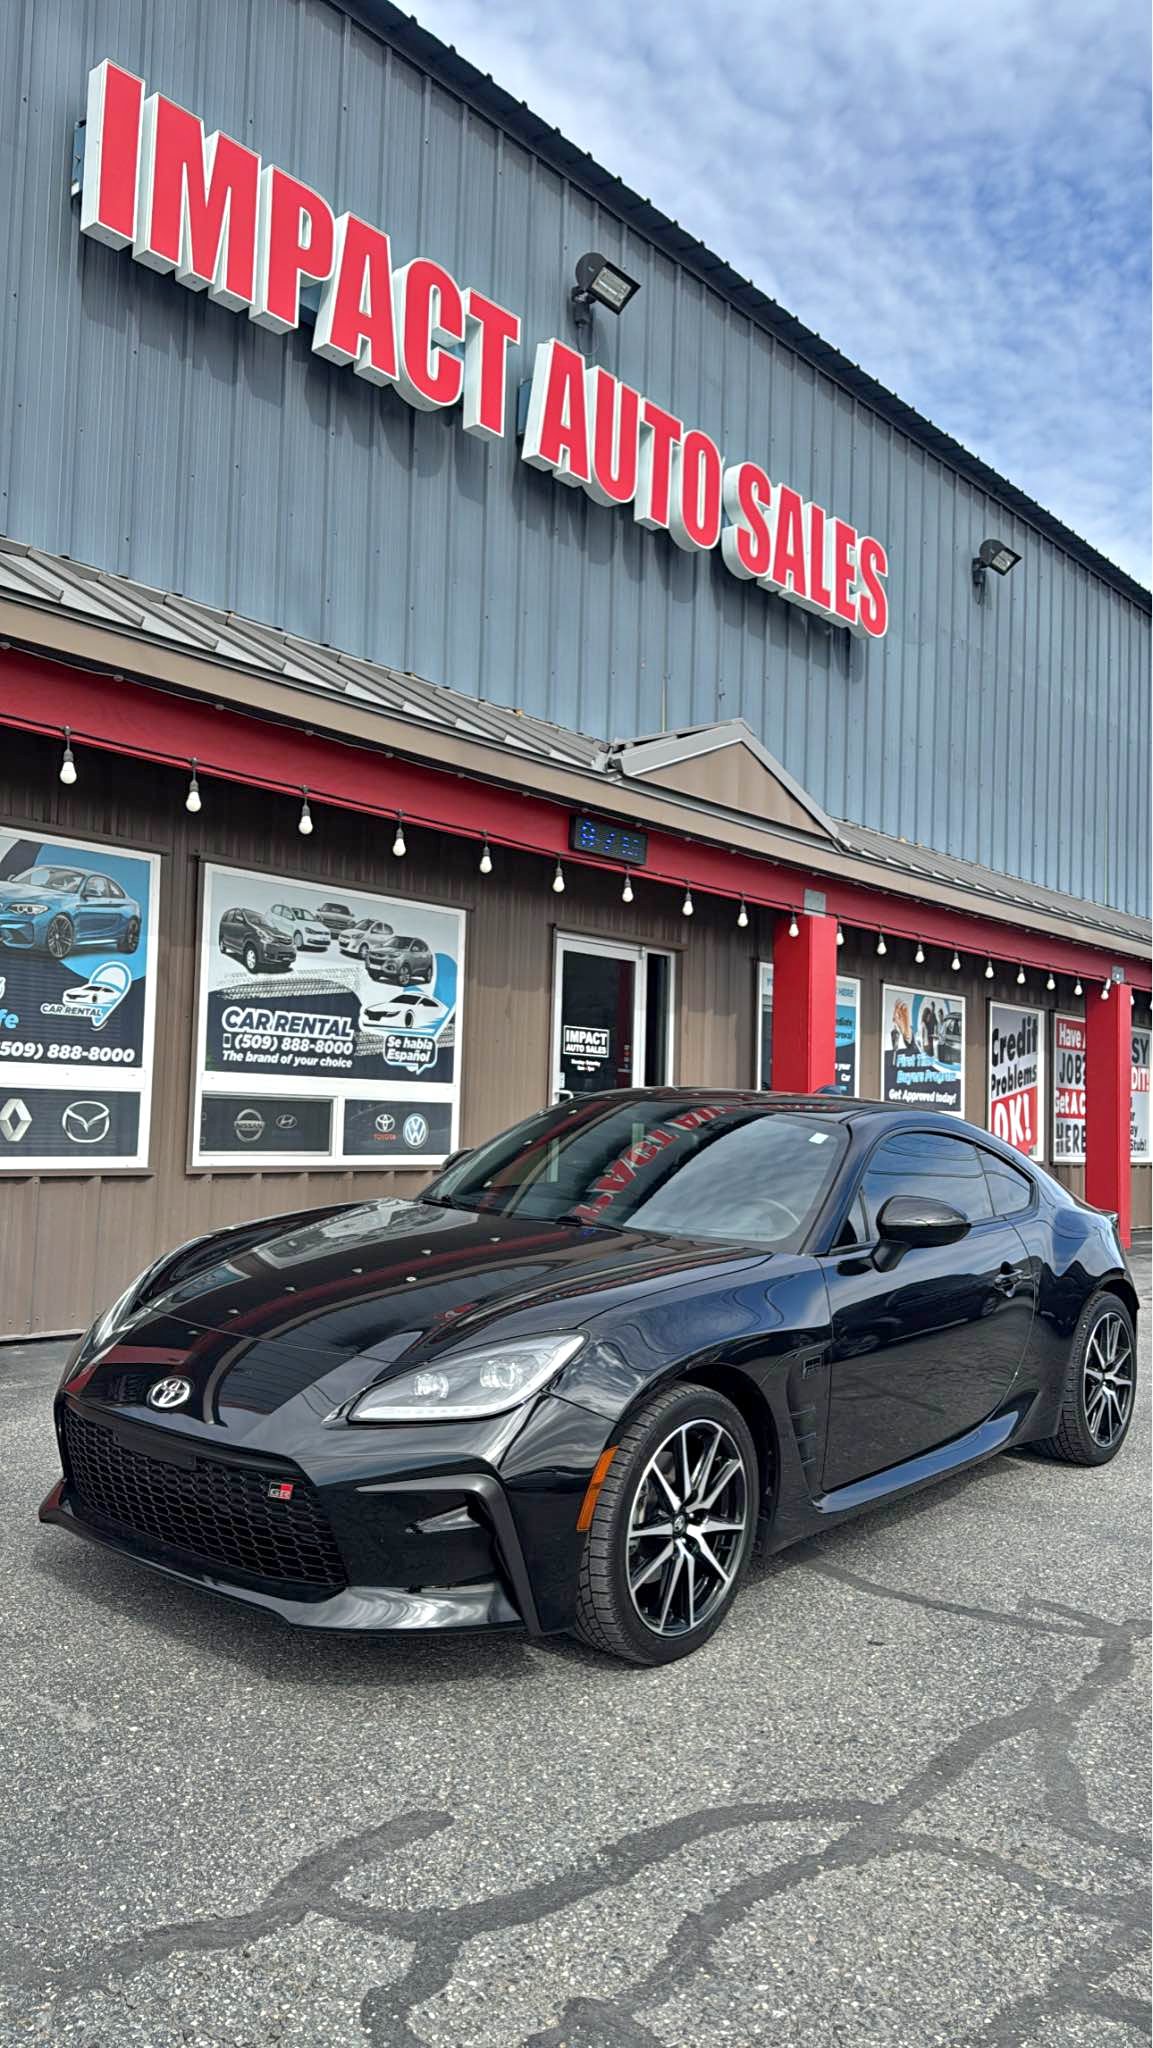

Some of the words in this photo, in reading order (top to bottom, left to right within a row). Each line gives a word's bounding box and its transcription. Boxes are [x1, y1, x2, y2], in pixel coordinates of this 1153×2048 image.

[86, 58, 521, 440] IMPACT
[523, 338, 721, 551] AUTO
[722, 462, 889, 638] SALES
[41, 1004, 64, 1014] CAR
[65, 1007, 101, 1016] RENTAL
[224, 1008, 271, 1032] CAR
[273, 1013, 354, 1038] RENTAL
[235, 1034, 278, 1051] (509)
[281, 1038, 353, 1055] 888-8000
[387, 1036, 401, 1048] Se
[403, 1037, 433, 1050] habla
[566, 1030, 607, 1045] IMPACT
[992, 1016, 1038, 1068] Credit
[1058, 1023, 1081, 1046] Have
[0, 1041, 44, 1060] 509)
[47, 1044, 135, 1063] 888-8000
[223, 1050, 244, 1061] The
[245, 1051, 279, 1064] brand
[281, 1054, 293, 1064] of
[293, 1057, 318, 1067] your
[320, 1057, 352, 1068] choice
[387, 1048, 431, 1062] Español
[566, 1044, 584, 1053] AUTO
[586, 1045, 606, 1055] SALES
[1131, 1037, 1149, 1064] SY
[896, 1070, 925, 1086] Buyers
[991, 1064, 1037, 1099] Problems
[1131, 1067, 1150, 1091] DIT!
[889, 1089, 902, 1101] Get
[902, 1090, 936, 1104] Approved
[936, 1091, 957, 1105] today!
[993, 1092, 1032, 1148] OK!
